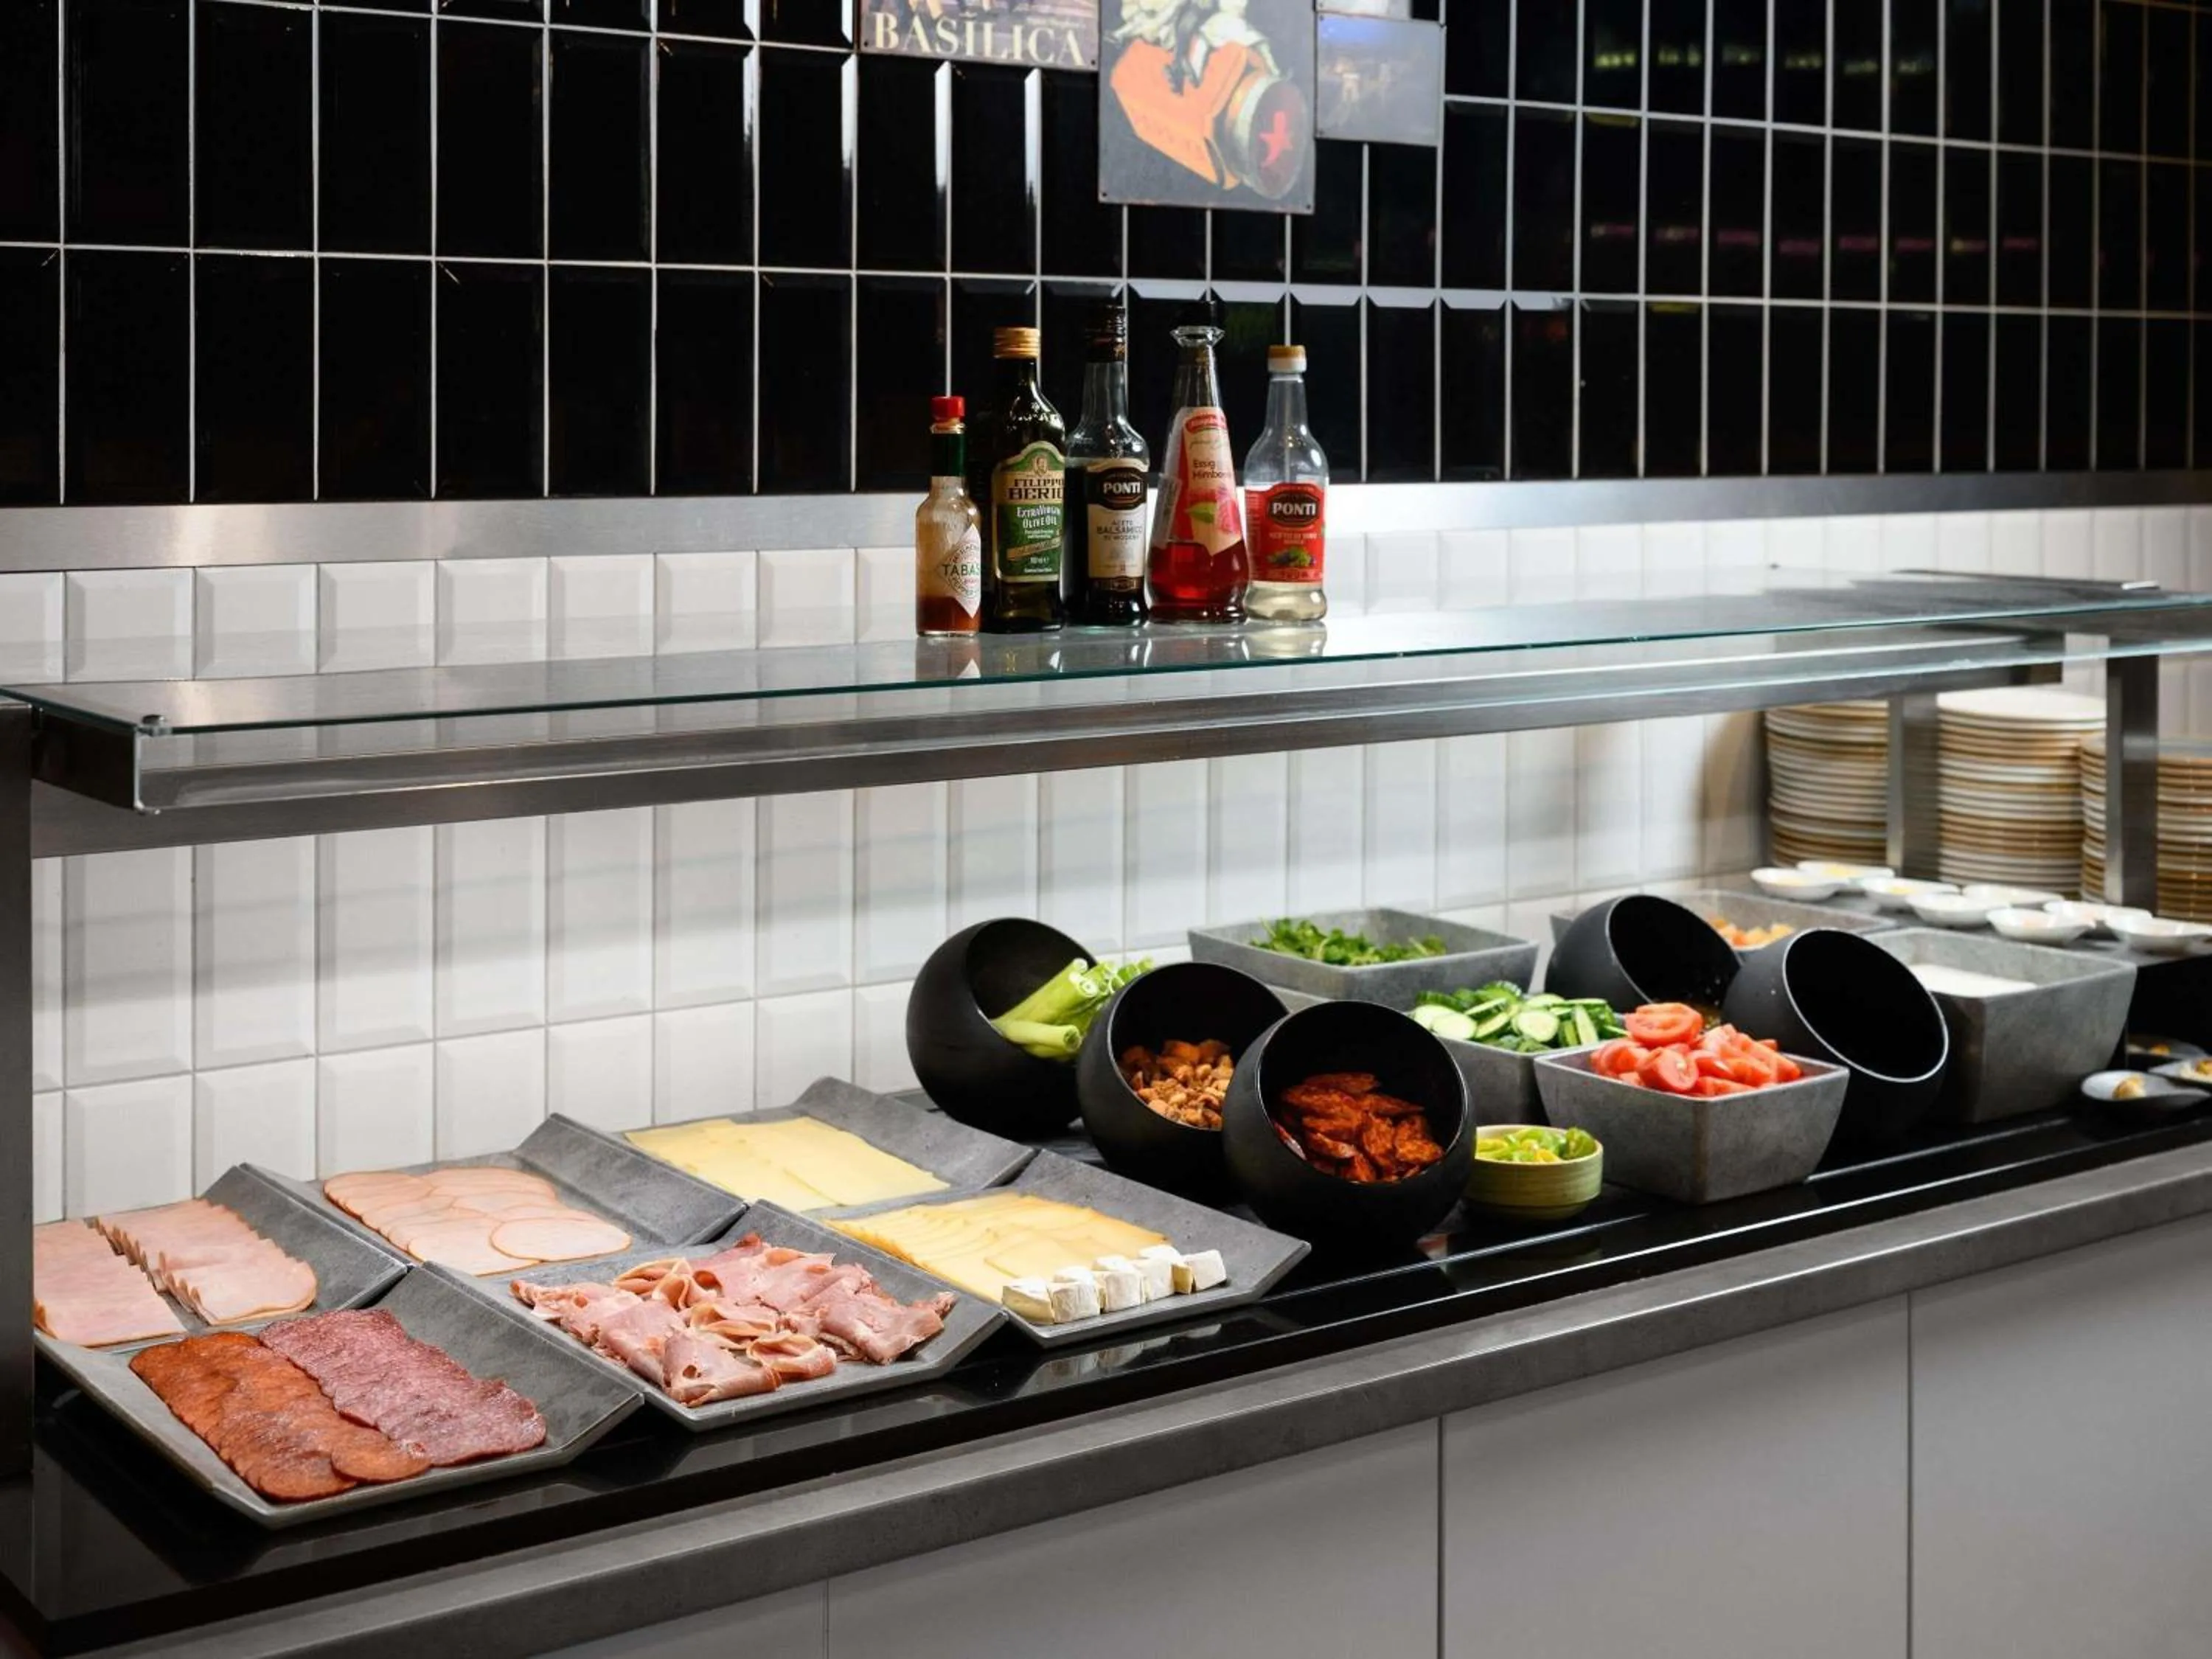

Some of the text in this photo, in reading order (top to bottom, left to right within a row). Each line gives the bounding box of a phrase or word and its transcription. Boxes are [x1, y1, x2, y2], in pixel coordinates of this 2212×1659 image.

[873, 12, 1085, 66] BASILICA
[1193, 460, 1215, 469] Essig
[1103, 481, 1141, 494] PONTI
[1272, 502, 1316, 515] PONTI
[1023, 515, 1057, 529] OLIVE OIL
